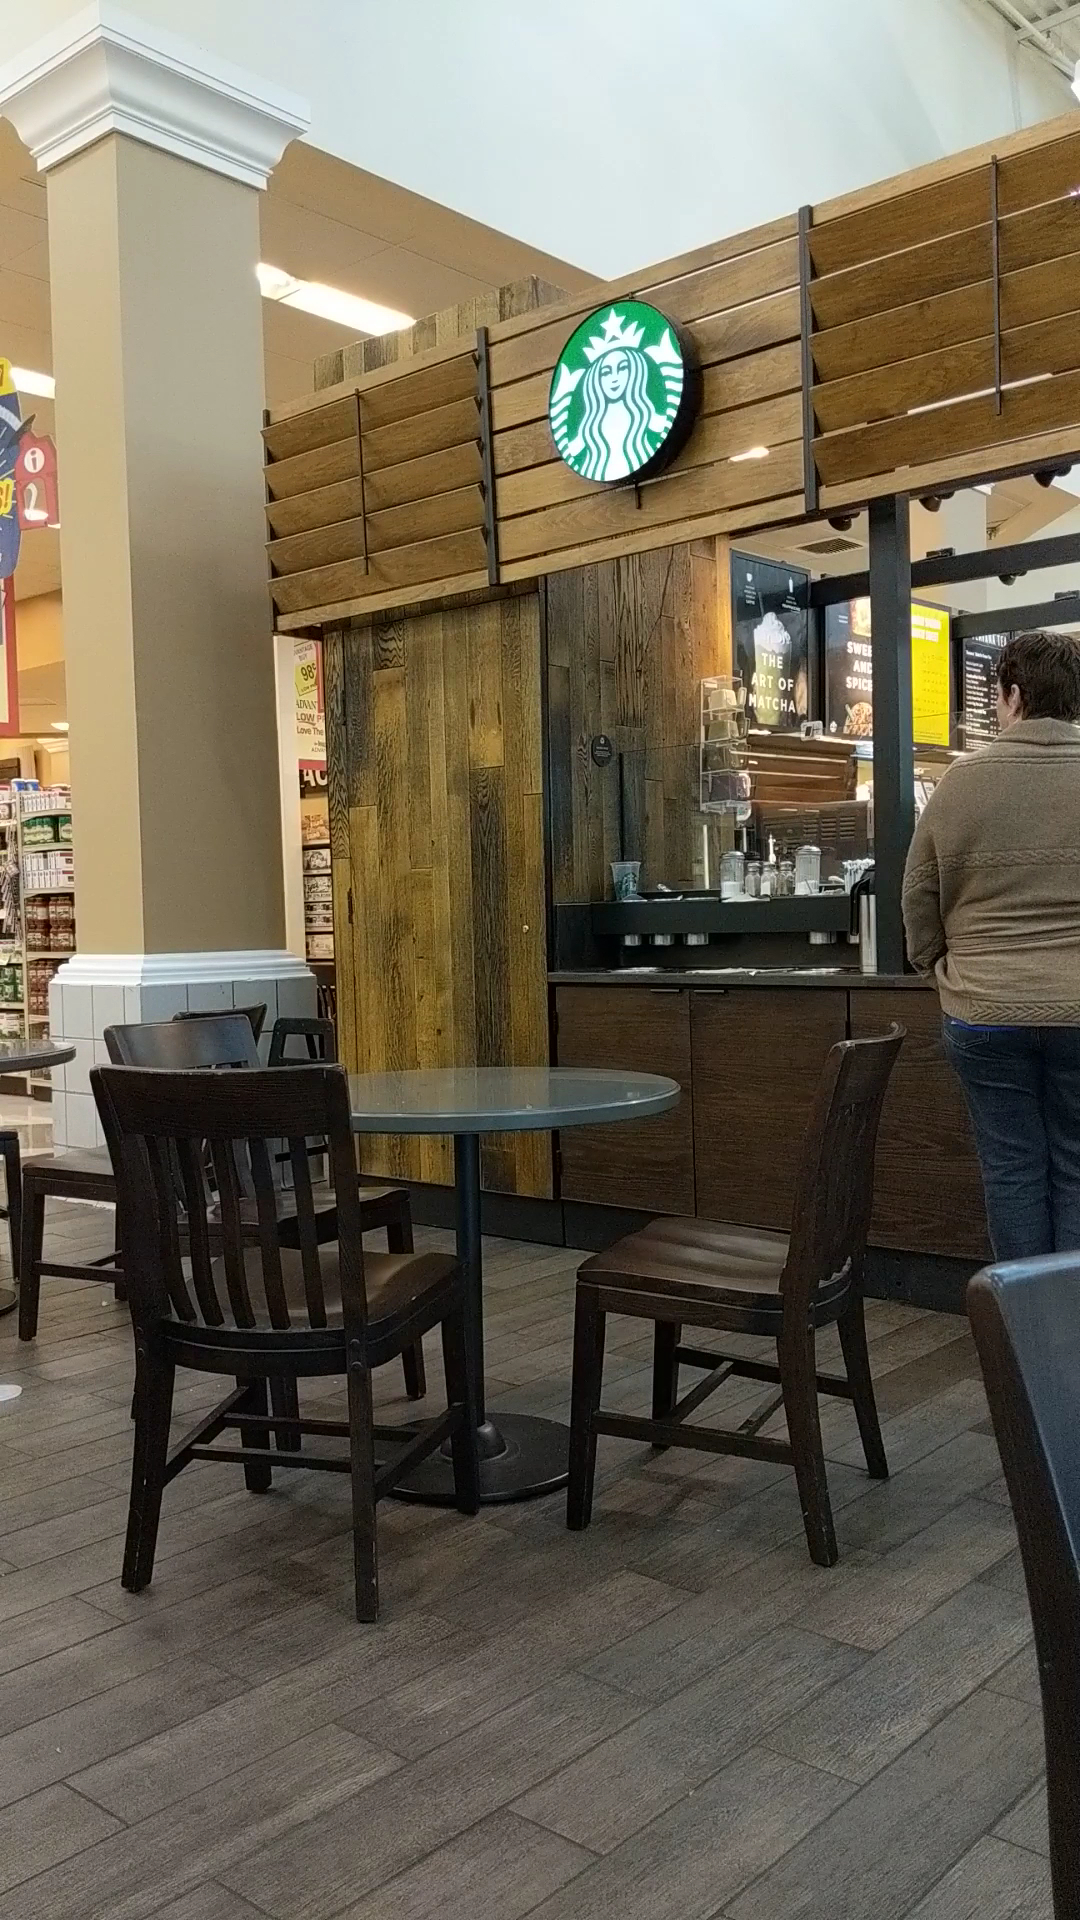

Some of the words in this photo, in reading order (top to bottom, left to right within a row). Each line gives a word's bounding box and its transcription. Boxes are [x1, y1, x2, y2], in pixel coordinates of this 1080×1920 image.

[761, 653, 783, 669] THE
[751, 672, 774, 689] ART
[778, 677, 794, 692] OF
[749, 693, 796, 713] MATCHA
[296, 712, 315, 721] LOW
[296, 726, 311, 735] Love
[313, 727, 323, 736] The
